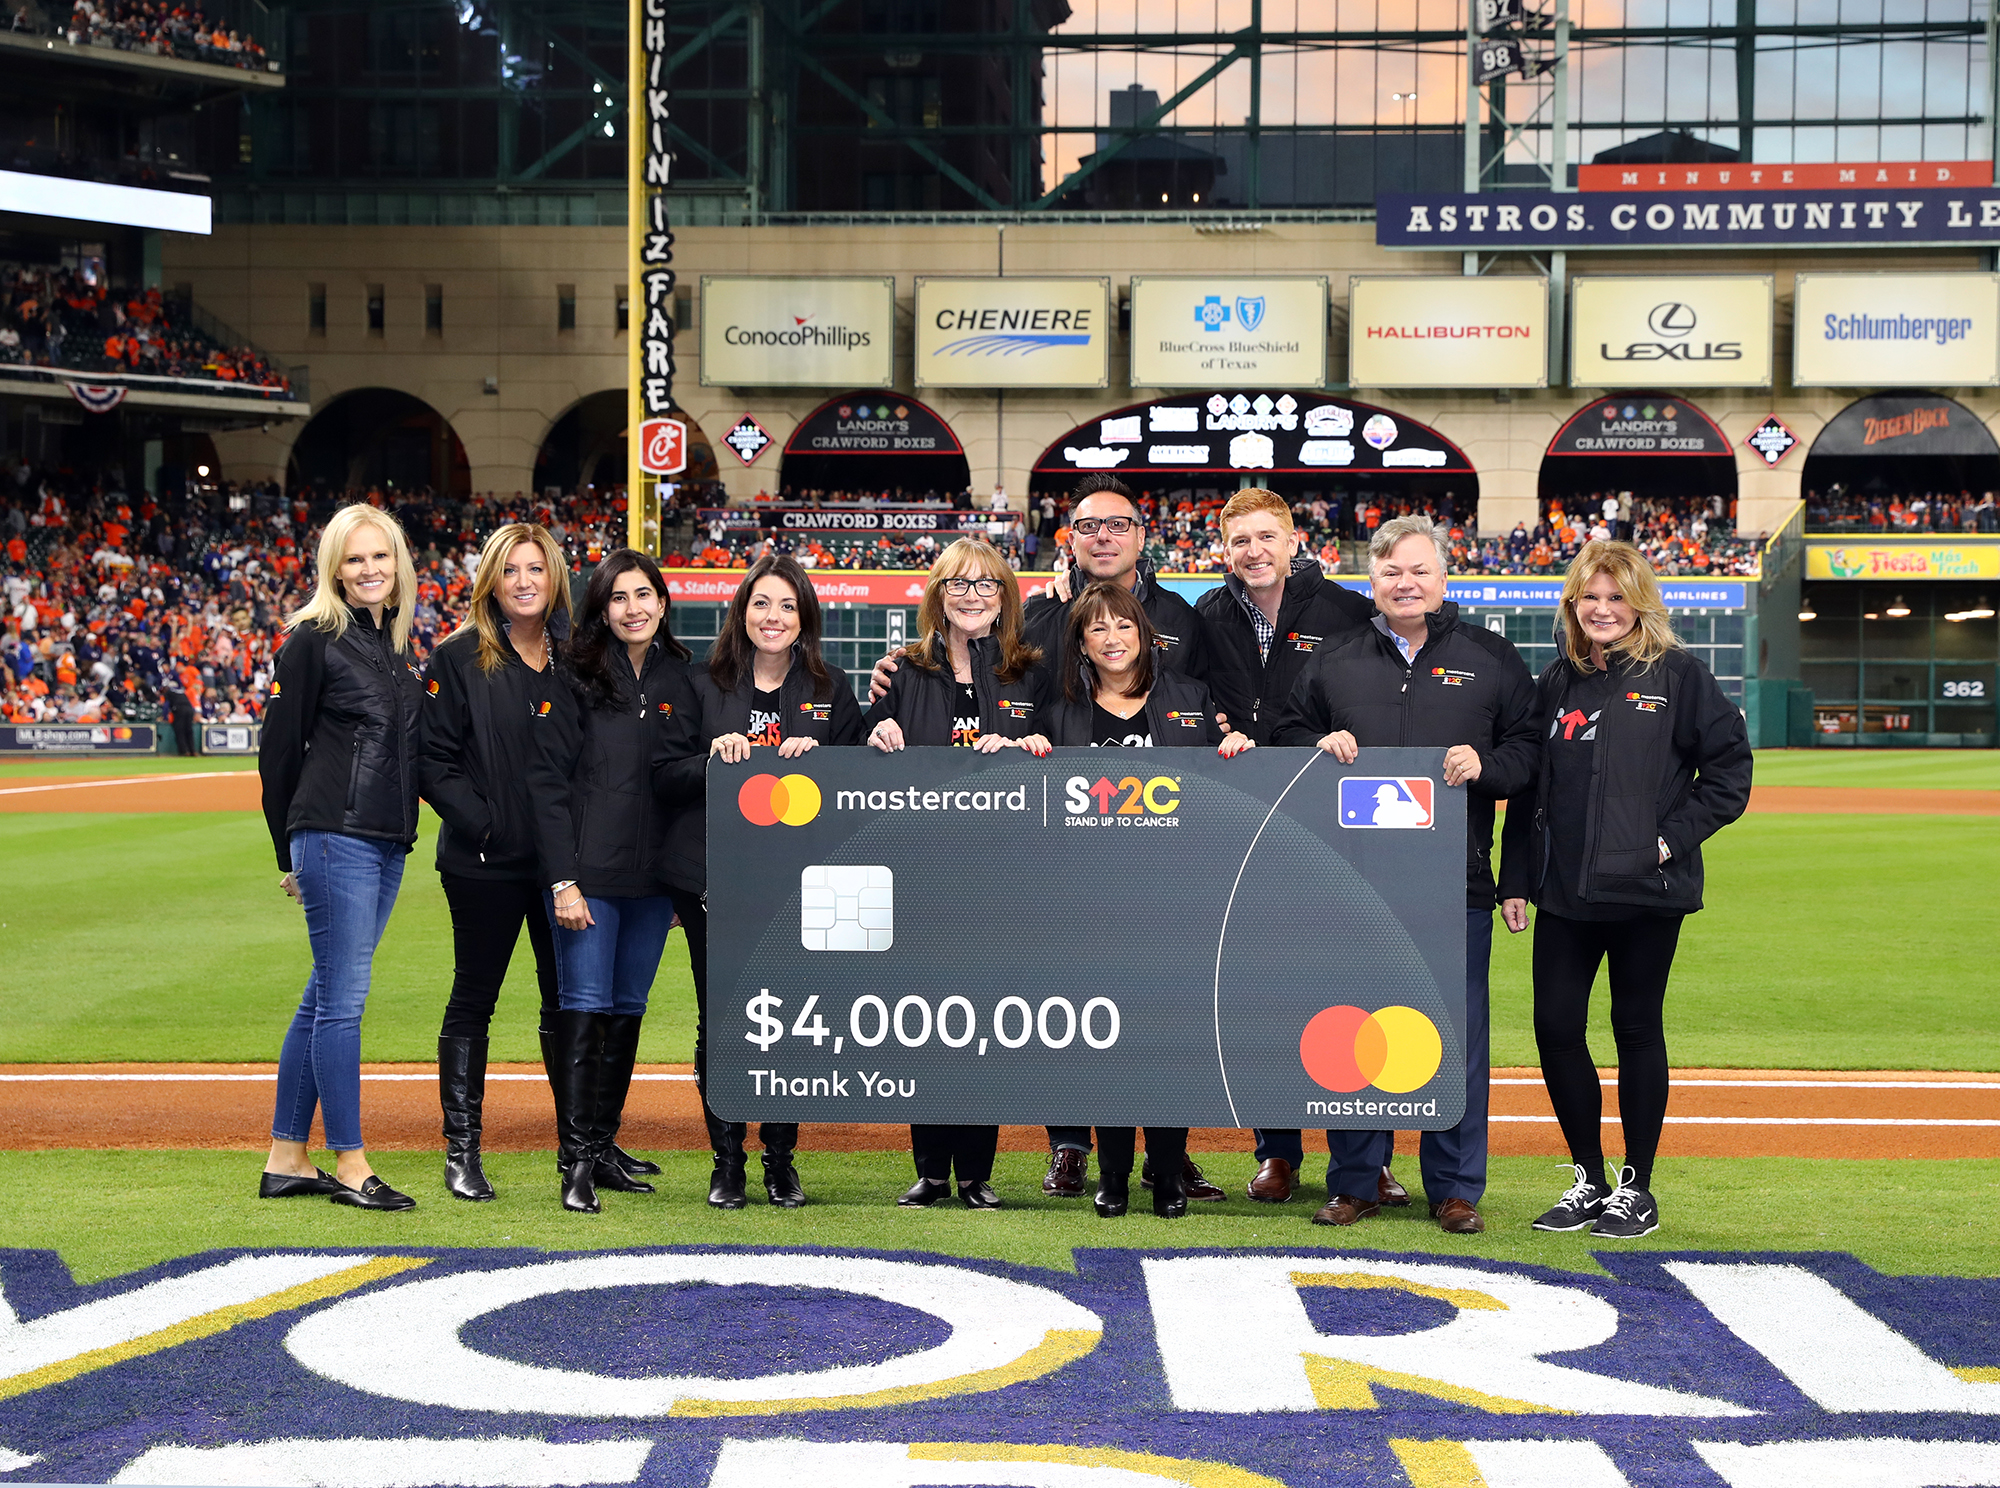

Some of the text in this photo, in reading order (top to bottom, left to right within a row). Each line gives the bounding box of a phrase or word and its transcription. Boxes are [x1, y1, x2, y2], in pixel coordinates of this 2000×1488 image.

[1482, 46, 1511, 71] 98
[1621, 167, 1951, 186] MINUTE MAID
[1406, 204, 1586, 232] ASTROS
[1610, 201, 1923, 231] COMMUNITY
[935, 309, 1092, 331] CHENIERE
[1367, 325, 1530, 339] HALLIBURTON
[1824, 313, 1973, 345] Schlumberger
[645, 272, 670, 412] FARE
[725, 325, 871, 351] ConocoPhillips
[1159, 340, 1300, 354] BlueCross BlueShield
[1600, 342, 1743, 361] LEXUS
[1201, 357, 1258, 370] of Texas
[836, 420, 910, 432] LANDRY'S
[1601, 420, 1678, 433] LANDRY'S
[812, 437, 936, 449] CRAWFORD BOXES
[1575, 437, 1705, 450] CRAWFORD BOXES
[726, 519, 761, 528] ANDRY'S
[782, 512, 938, 529] CRAWFORD BOXES
[1869, 549, 1928, 574] Fiesta
[1938, 560, 1979, 575] Fresh
[1444, 590, 1482, 599] NITED
[1498, 590, 1561, 600] AIRLINES
[1664, 591, 1728, 600] AIRLINES
[1942, 680, 1985, 697] 362
[1064, 816, 1180, 828] STAND UP TO CANCER
[744, 988, 1121, 1056] $4,000,000
[748, 1070, 917, 1098] Thank You
